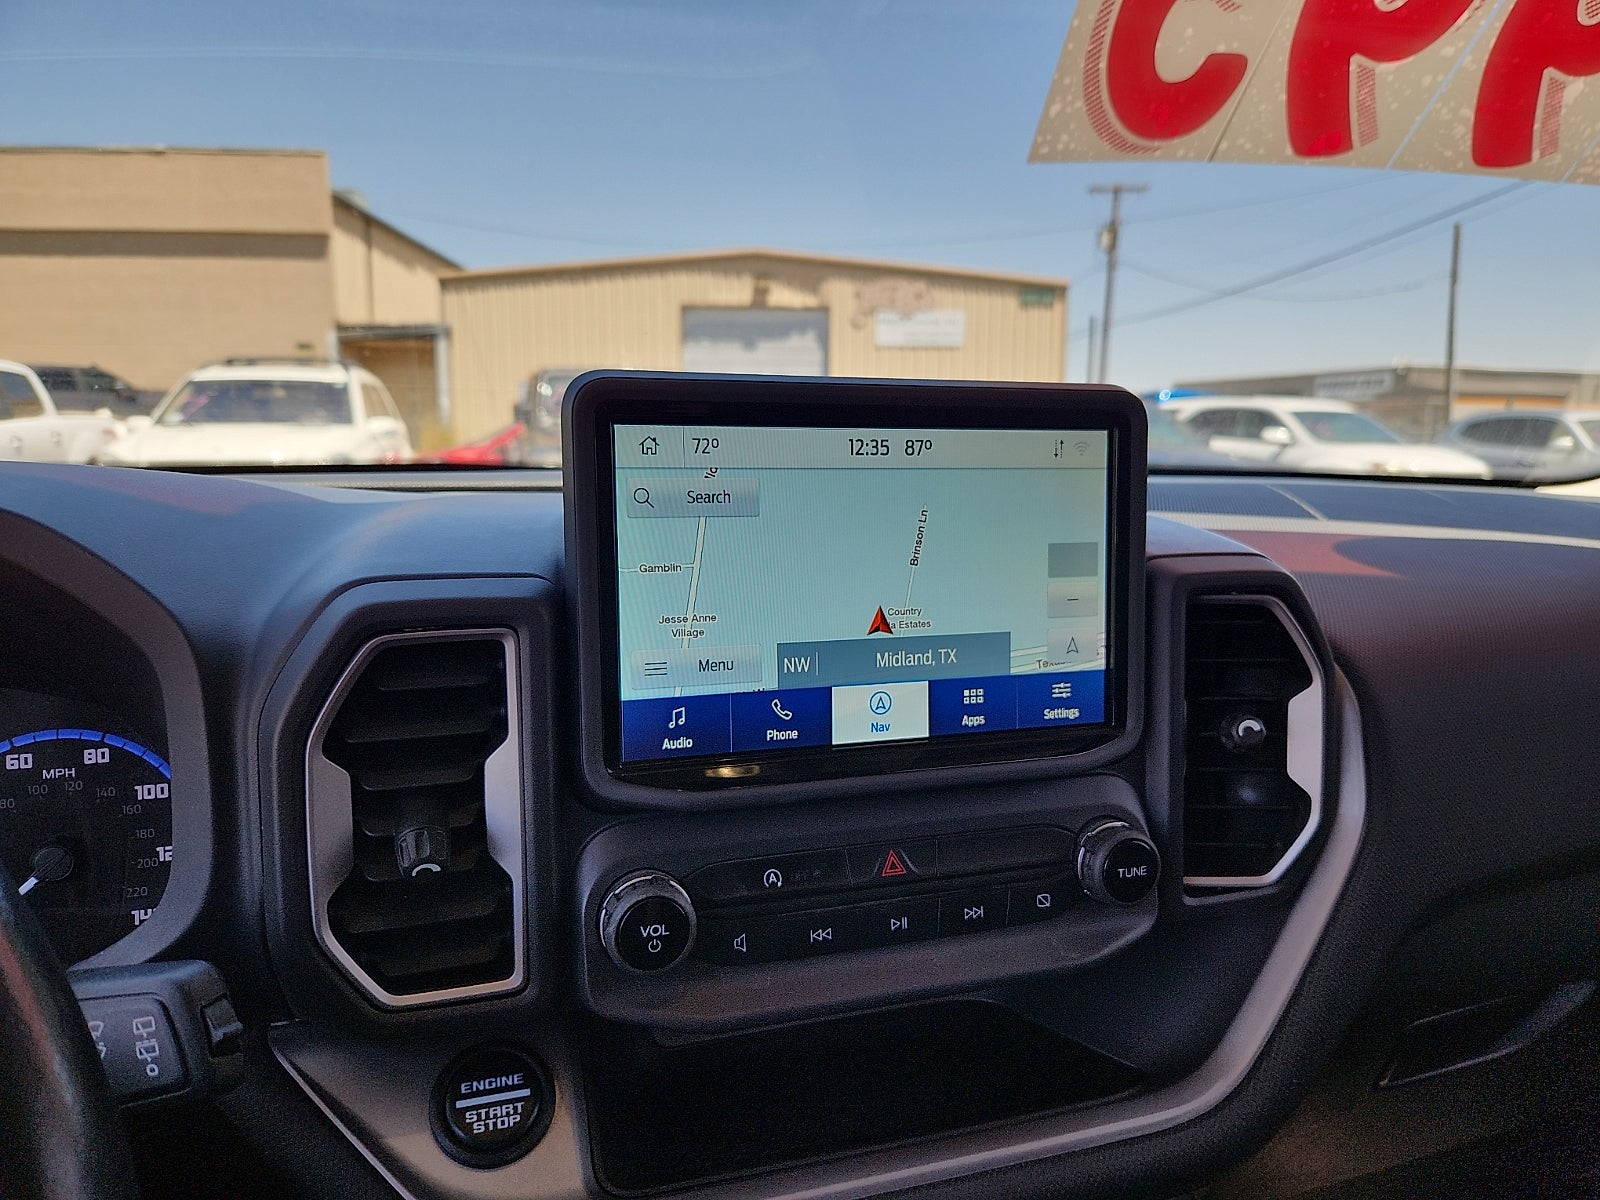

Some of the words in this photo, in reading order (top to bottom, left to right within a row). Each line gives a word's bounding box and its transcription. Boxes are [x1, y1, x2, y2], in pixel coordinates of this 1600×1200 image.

[692, 437, 719, 455] 72°
[848, 438, 890, 456] 12:35
[904, 439, 933, 456] 87°
[687, 489, 731, 504] Search
[917, 509, 929, 524] Ln
[909, 525, 926, 567] Brinson
[639, 563, 682, 573] Gamblin
[659, 615, 689, 625] Jesse
[691, 614, 717, 623] Anne
[887, 607, 922, 617] Country
[898, 619, 932, 629] Estates
[671, 628, 705, 639] Village
[698, 658, 734, 673] Menu
[783, 656, 811, 674] NW
[876, 649, 935, 668] Midland,
[938, 648, 957, 664] TX
[961, 713, 986, 728] Apps
[1043, 707, 1080, 720] Settings
[870, 721, 891, 733] Nav
[766, 728, 798, 742] Phone
[662, 736, 693, 751] Audio
[5, 753, 33, 770] 60
[83, 748, 110, 765] 80
[42, 767, 76, 780] MPH
[28, 784, 48, 795] 100
[64, 780, 83, 791] 120
[97, 786, 116, 798] 140
[134, 783, 169, 800] 100
[122, 804, 142, 815] 160
[136, 828, 155, 839] 180
[155, 845, 173, 862] 12
[137, 857, 159, 869] 200
[1117, 865, 1148, 879] TUNE
[126, 886, 148, 898] 220
[131, 908, 156, 925] 14
[640, 923, 671, 938] VOL
[460, 1072, 524, 1094] ENGINE
[465, 1101, 525, 1123] START
[472, 1114, 521, 1134] STOP
